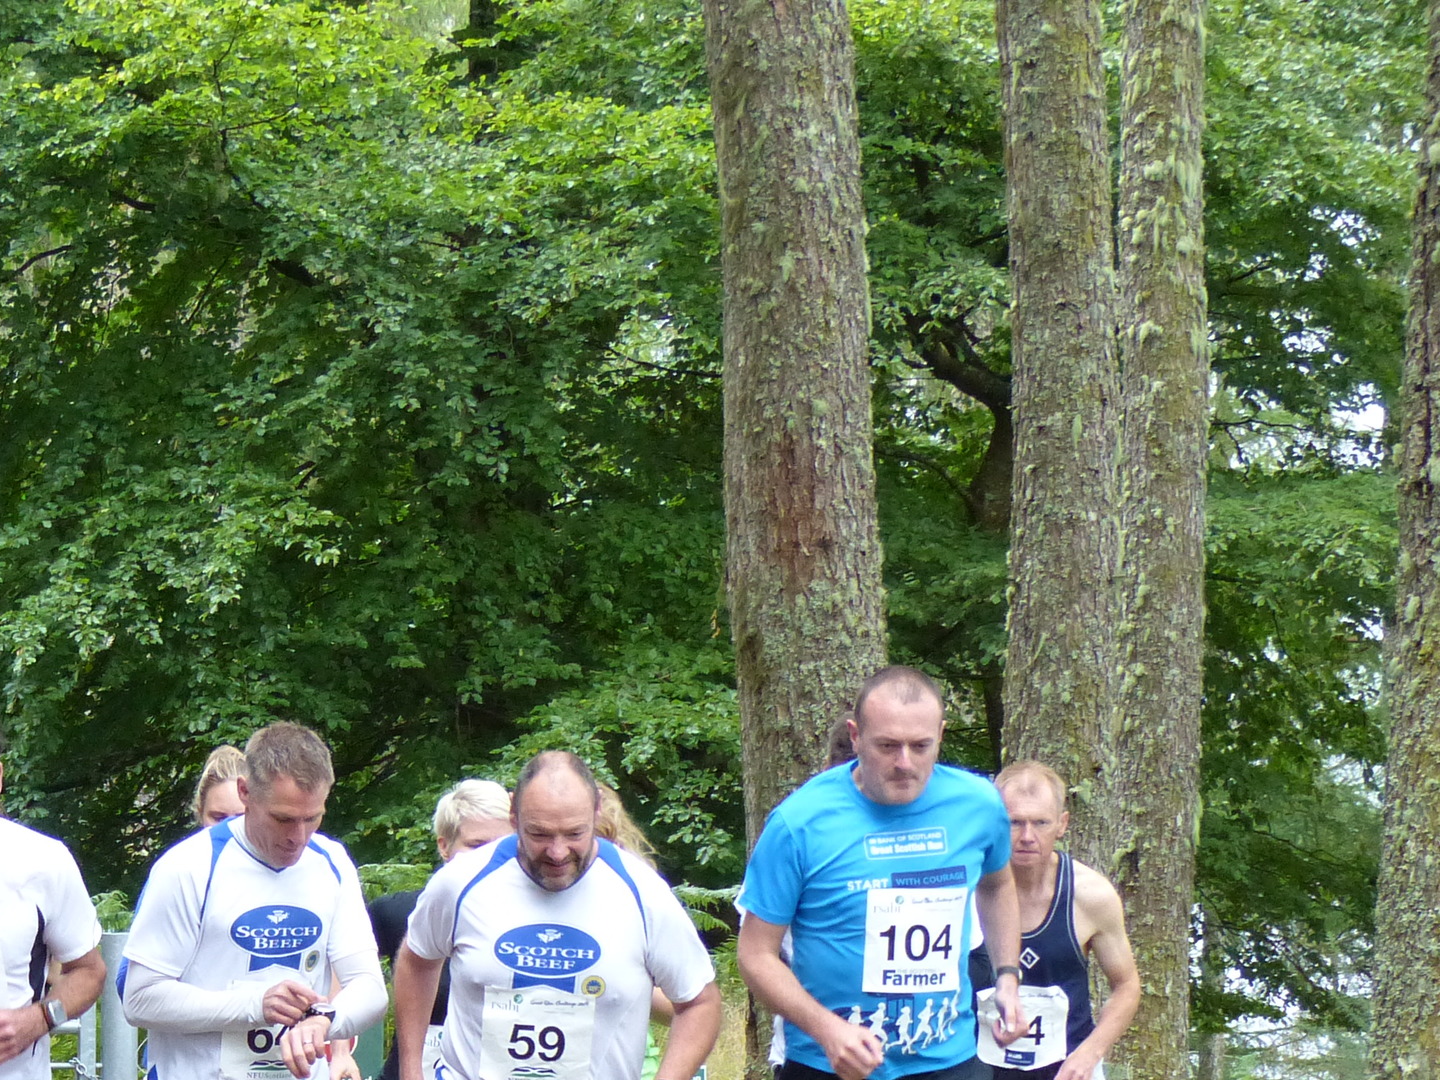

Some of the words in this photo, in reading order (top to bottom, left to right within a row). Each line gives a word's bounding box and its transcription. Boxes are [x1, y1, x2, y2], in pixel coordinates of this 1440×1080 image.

[847, 878, 889, 891] START
[895, 877, 921, 886] WITH
[923, 872, 965, 885] COURAGE
[235, 925, 319, 938] SCOTCH
[253, 937, 303, 949] BEEF
[498, 941, 595, 959] SCOTCH
[879, 924, 952, 962] 104
[516, 955, 576, 970] BEEF
[882, 969, 946, 986] Farmer
[507, 1023, 566, 1062] 59
